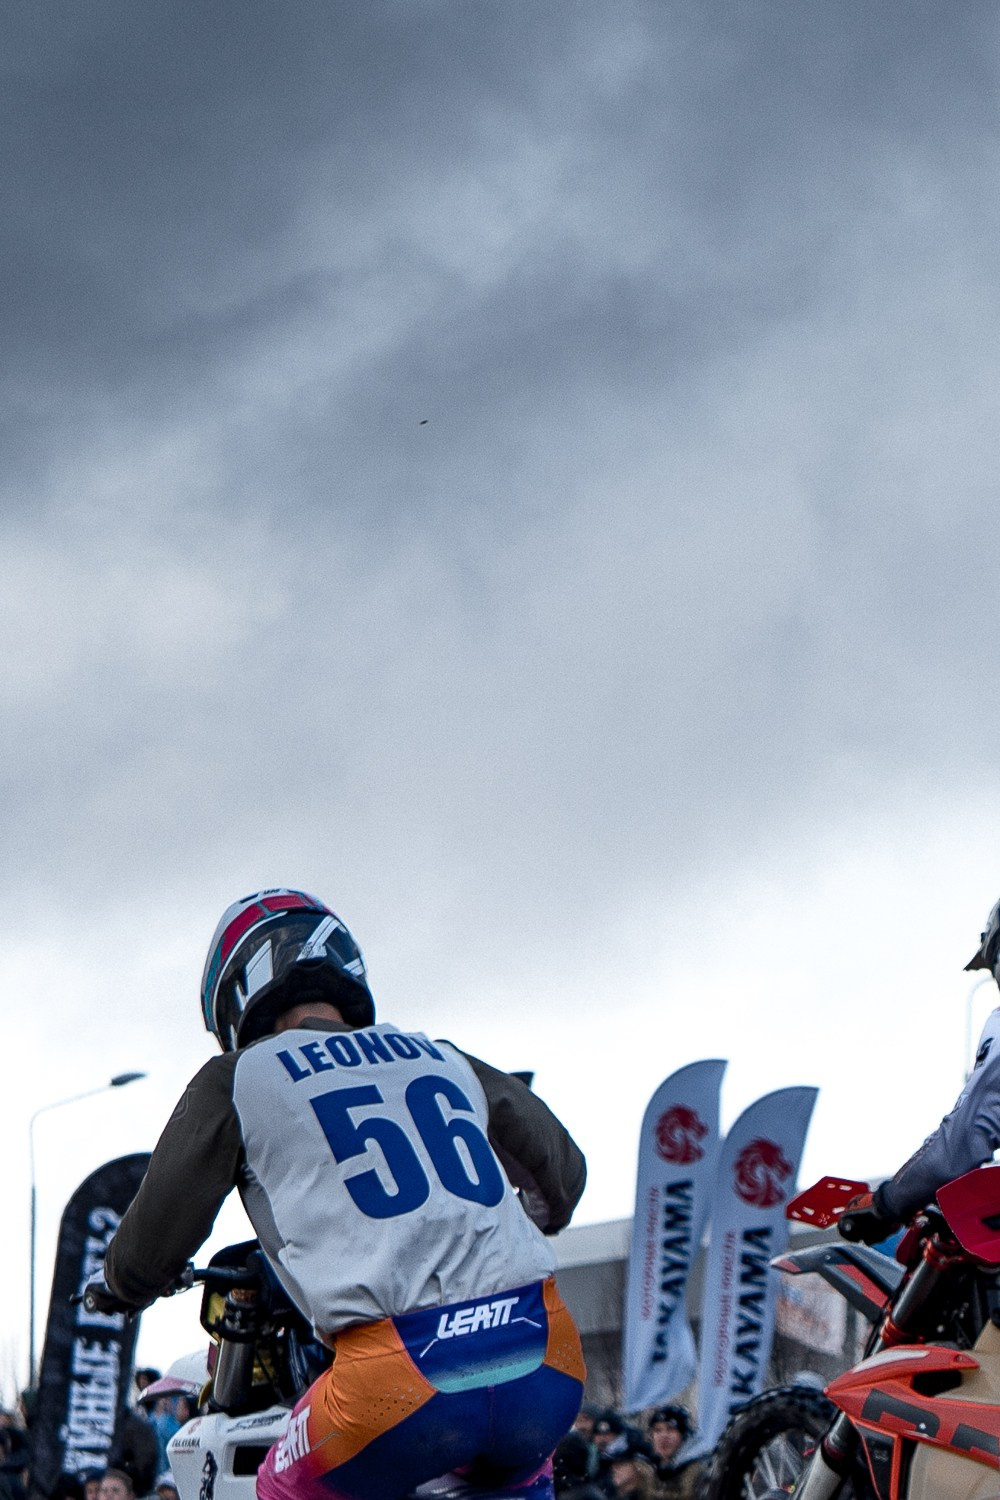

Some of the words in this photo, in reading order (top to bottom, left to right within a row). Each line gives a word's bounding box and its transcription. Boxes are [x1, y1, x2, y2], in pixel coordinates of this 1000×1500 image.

[276, 1031, 447, 1083] LEONOV
[309, 1074, 506, 1220] 56
[437, 1296, 520, 1340] LEATT
